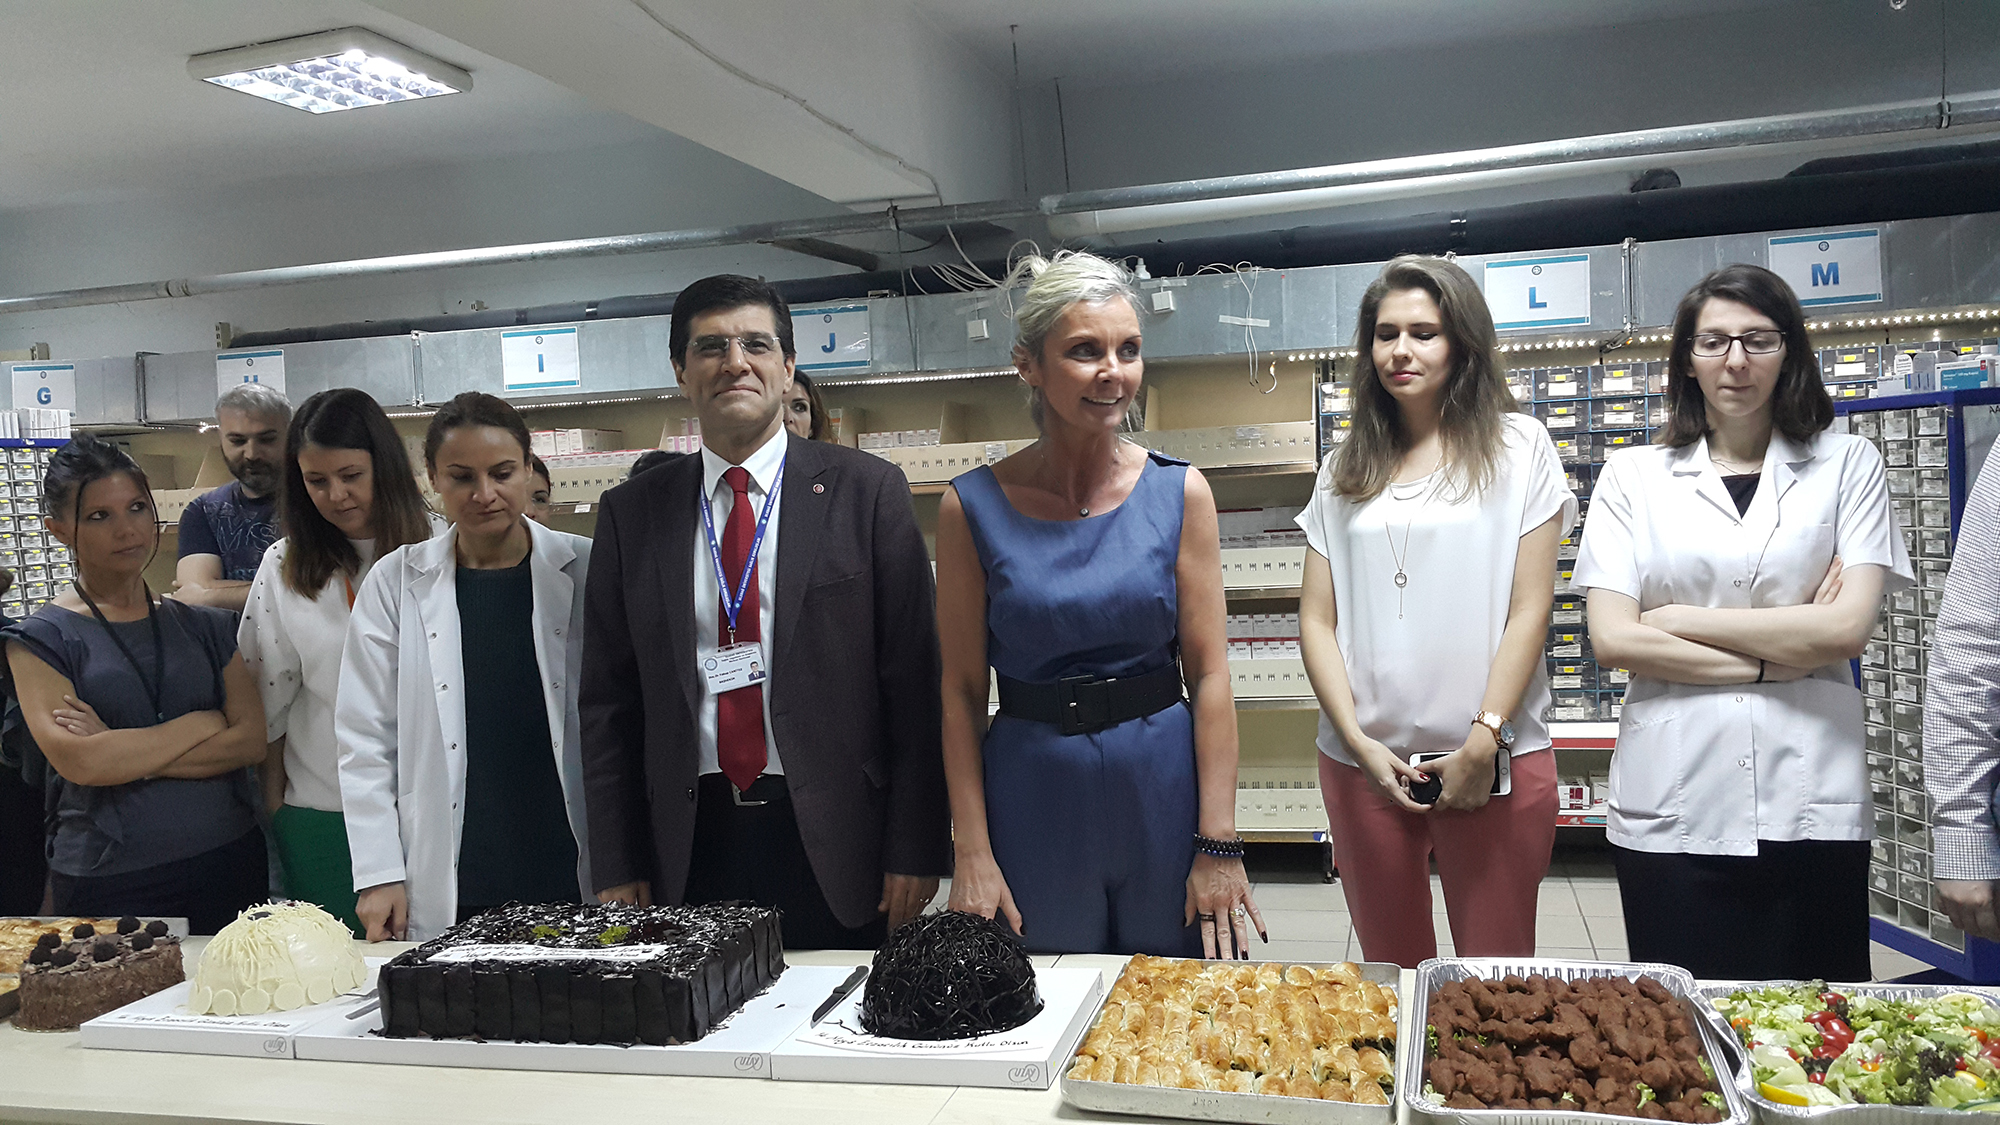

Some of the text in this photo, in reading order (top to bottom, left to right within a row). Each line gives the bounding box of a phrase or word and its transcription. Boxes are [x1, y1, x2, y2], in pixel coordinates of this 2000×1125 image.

[1811, 262, 1840, 287] M
[1529, 287, 1547, 309] L
[821, 332, 836, 353] J
[537, 353, 544, 373] I
[36, 386, 52, 405] G
